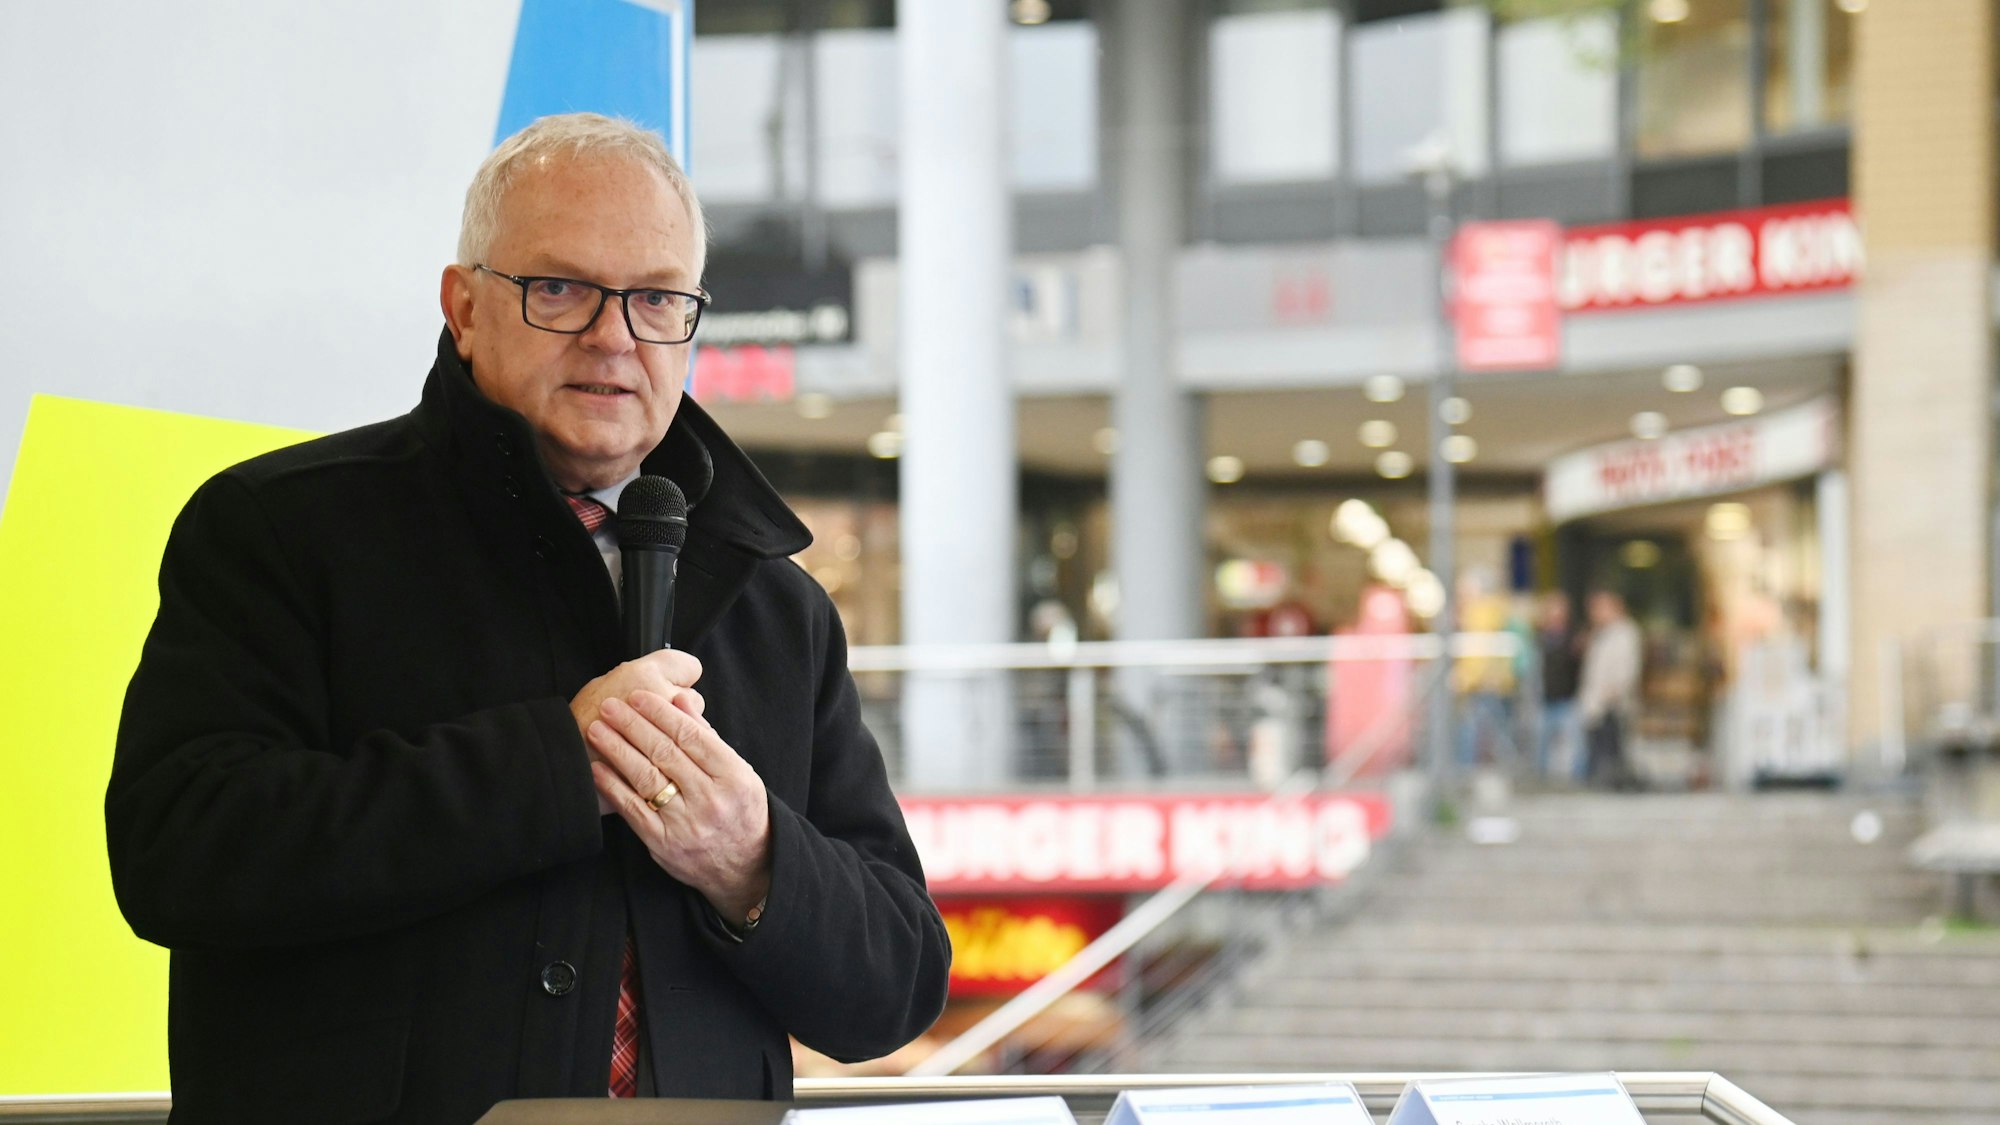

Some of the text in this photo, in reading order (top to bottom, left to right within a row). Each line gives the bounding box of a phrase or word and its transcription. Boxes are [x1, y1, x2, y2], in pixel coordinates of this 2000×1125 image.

[1558, 221, 1757, 307] URGER
[1759, 211, 1864, 289] KIN
[902, 800, 1371, 881] URGER KING
